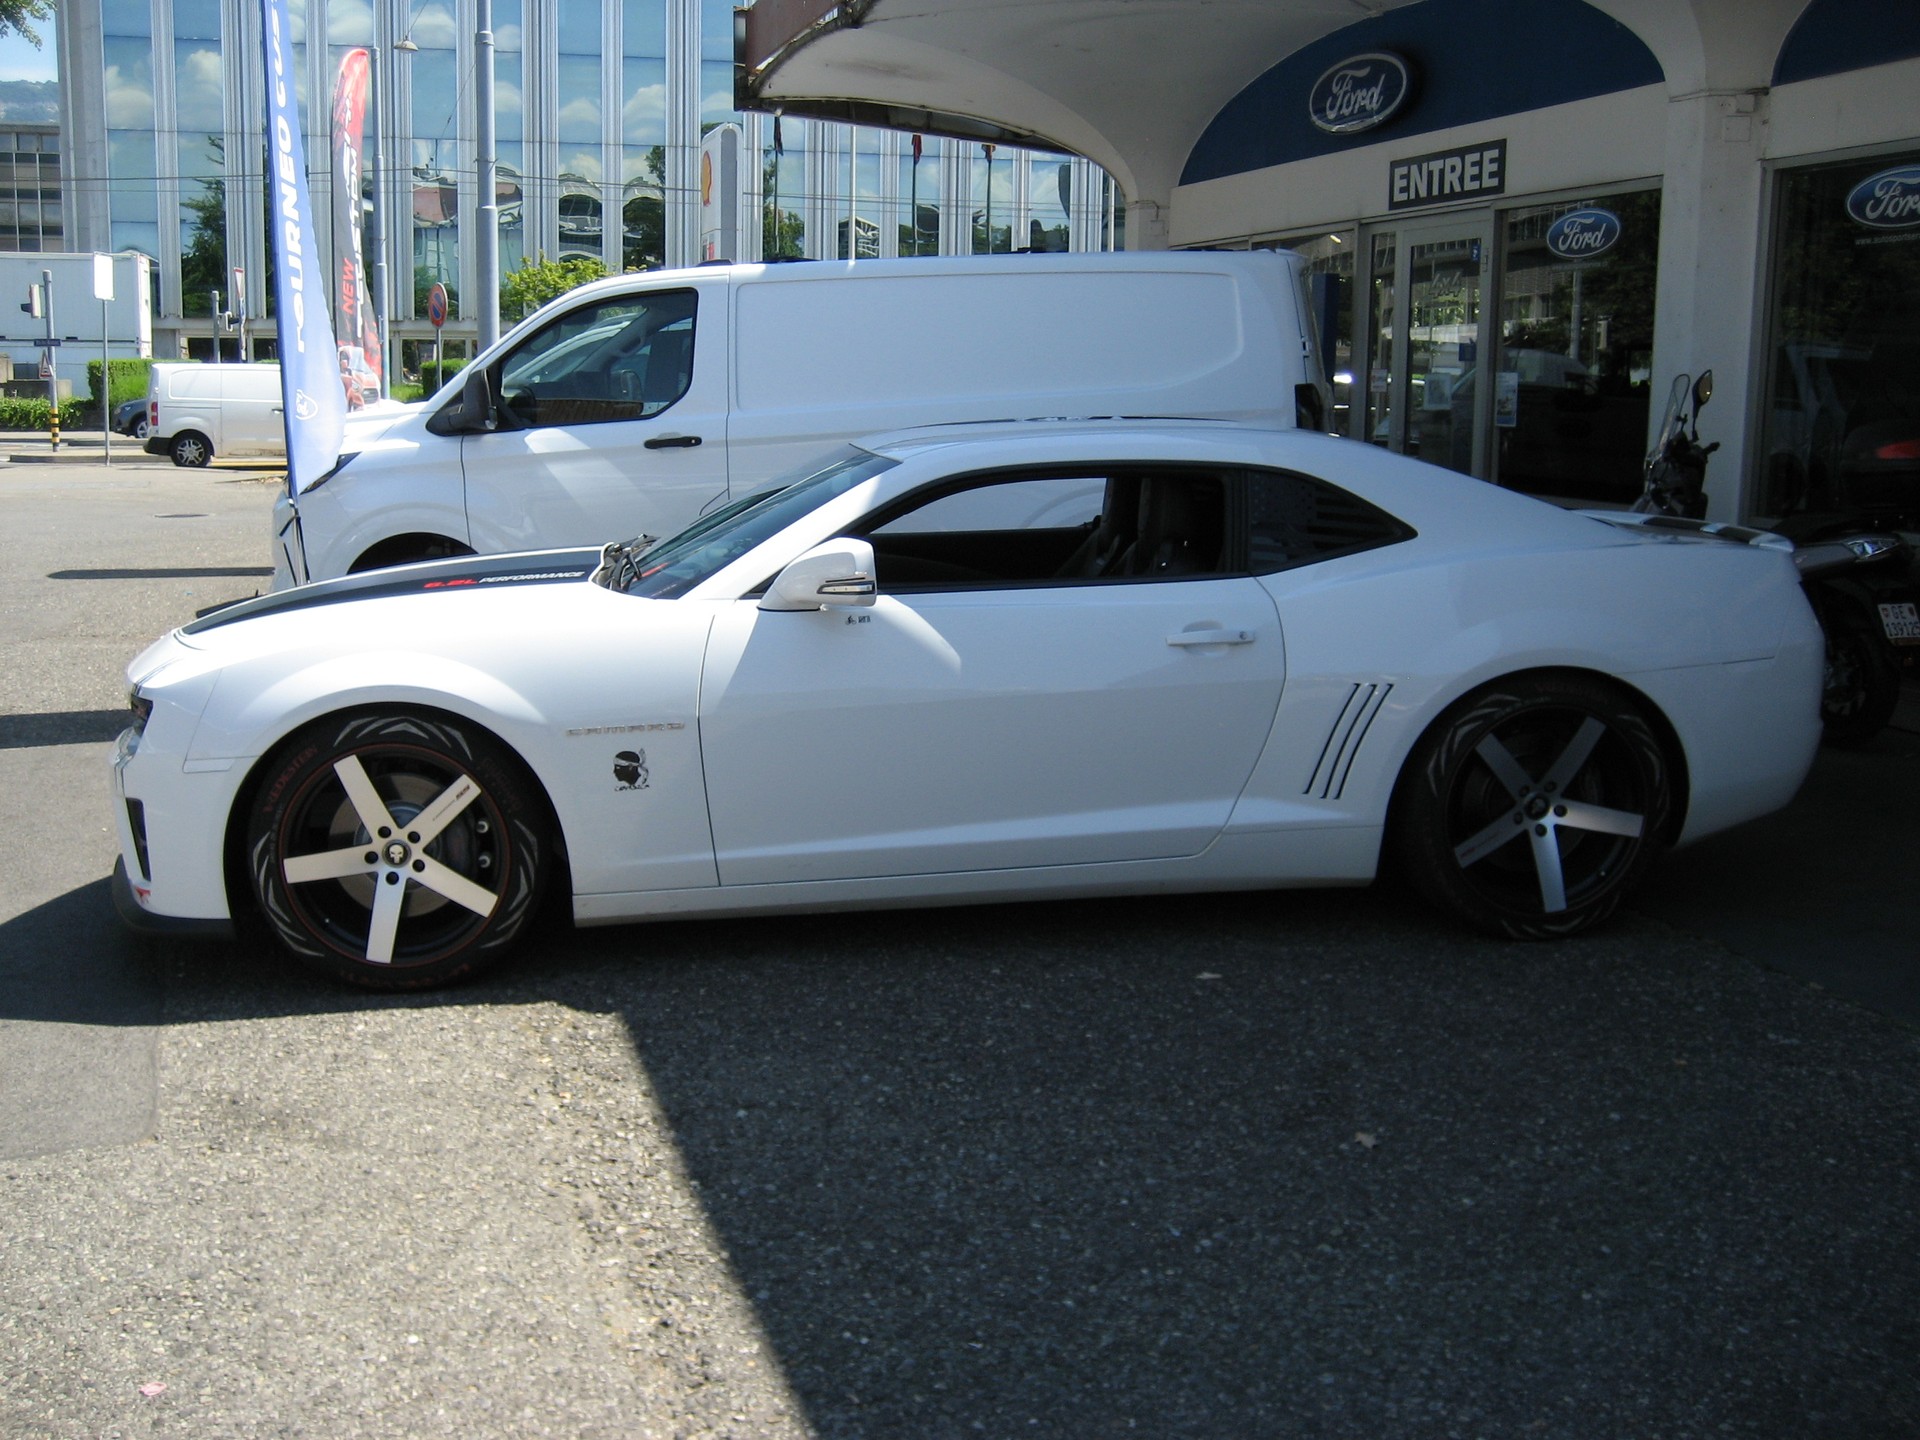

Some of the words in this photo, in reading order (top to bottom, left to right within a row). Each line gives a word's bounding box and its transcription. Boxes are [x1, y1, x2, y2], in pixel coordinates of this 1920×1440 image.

[271, 0, 287, 108] CUS
[1326, 65, 1386, 120] Ford
[1393, 148, 1500, 203] ENTREE
[1865, 176, 1920, 220] For
[277, 115, 305, 353] TOURNEO
[1558, 216, 1608, 252] Ford
[342, 257, 356, 315] NEW
[479, 571, 586, 584] PERFORMANCE
[1891, 605, 1907, 619] GE
[565, 722, 686, 737] CAMARO
